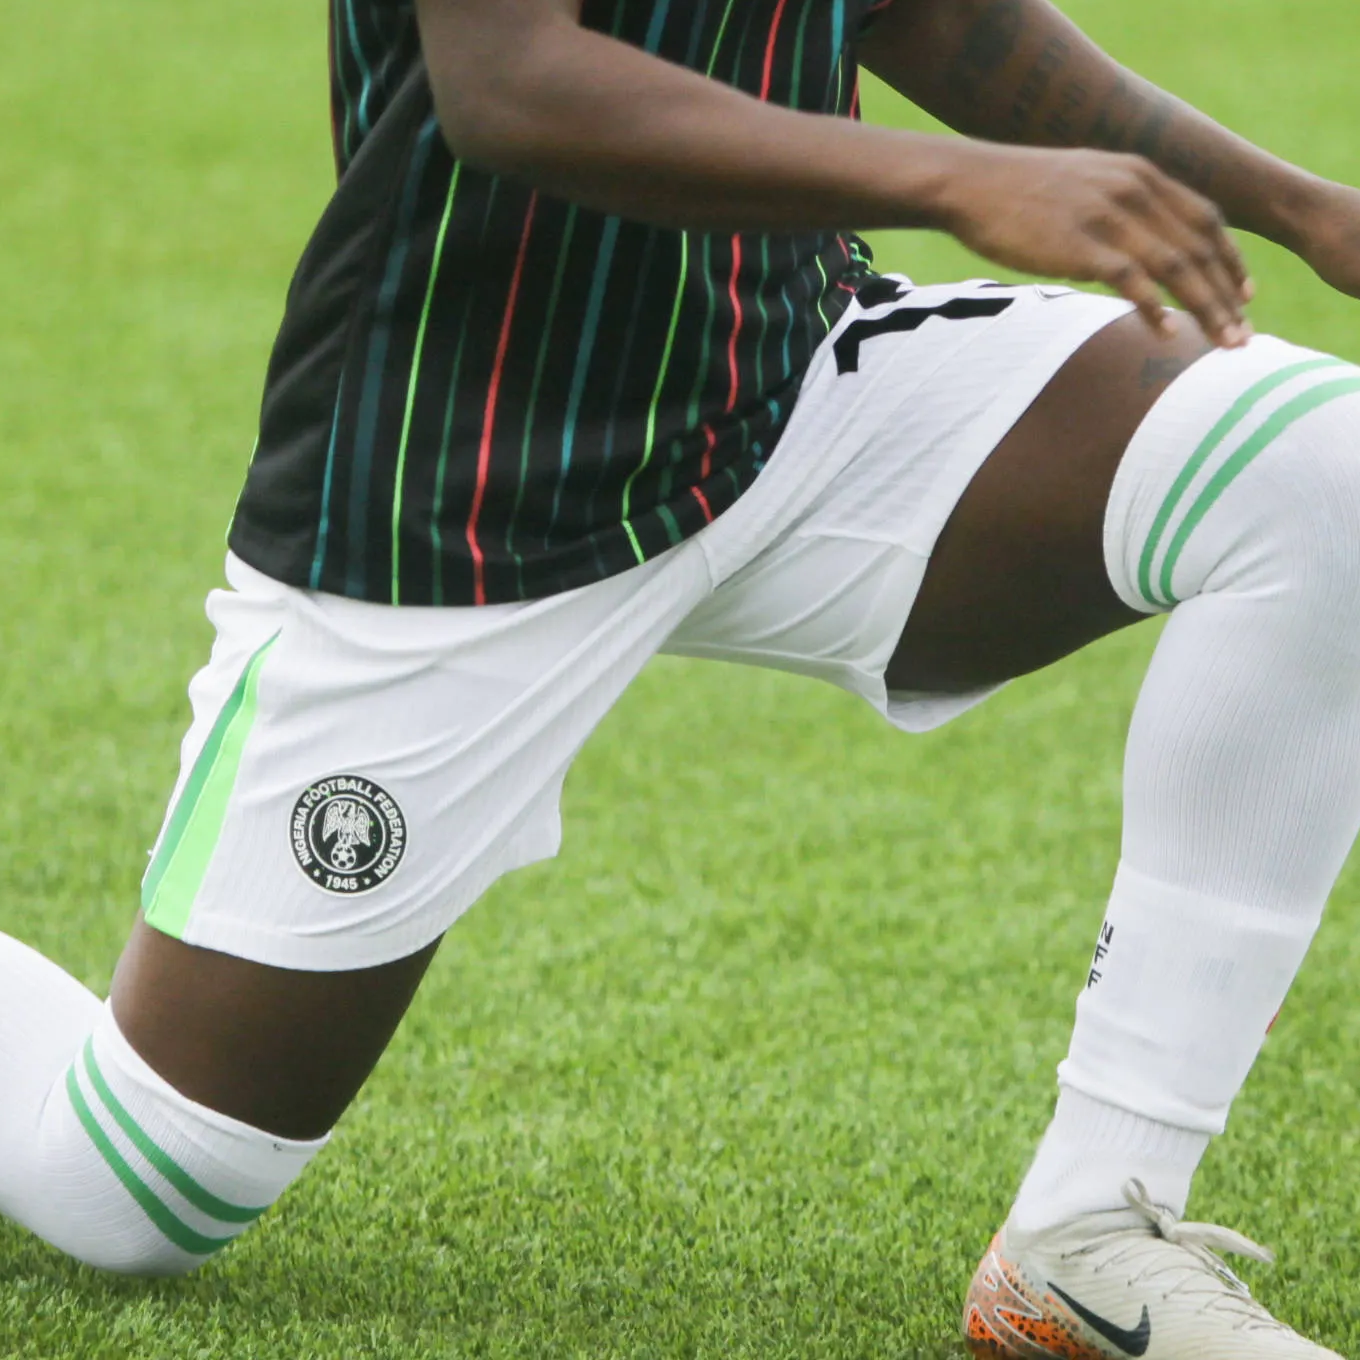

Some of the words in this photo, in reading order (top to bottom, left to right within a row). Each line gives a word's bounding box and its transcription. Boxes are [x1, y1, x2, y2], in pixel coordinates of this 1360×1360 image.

[302, 777, 373, 808] FOOTBALL
[293, 806, 313, 867] NIGERIA
[373, 791, 404, 879] FEDERATION
[325, 874, 358, 890] 1945
